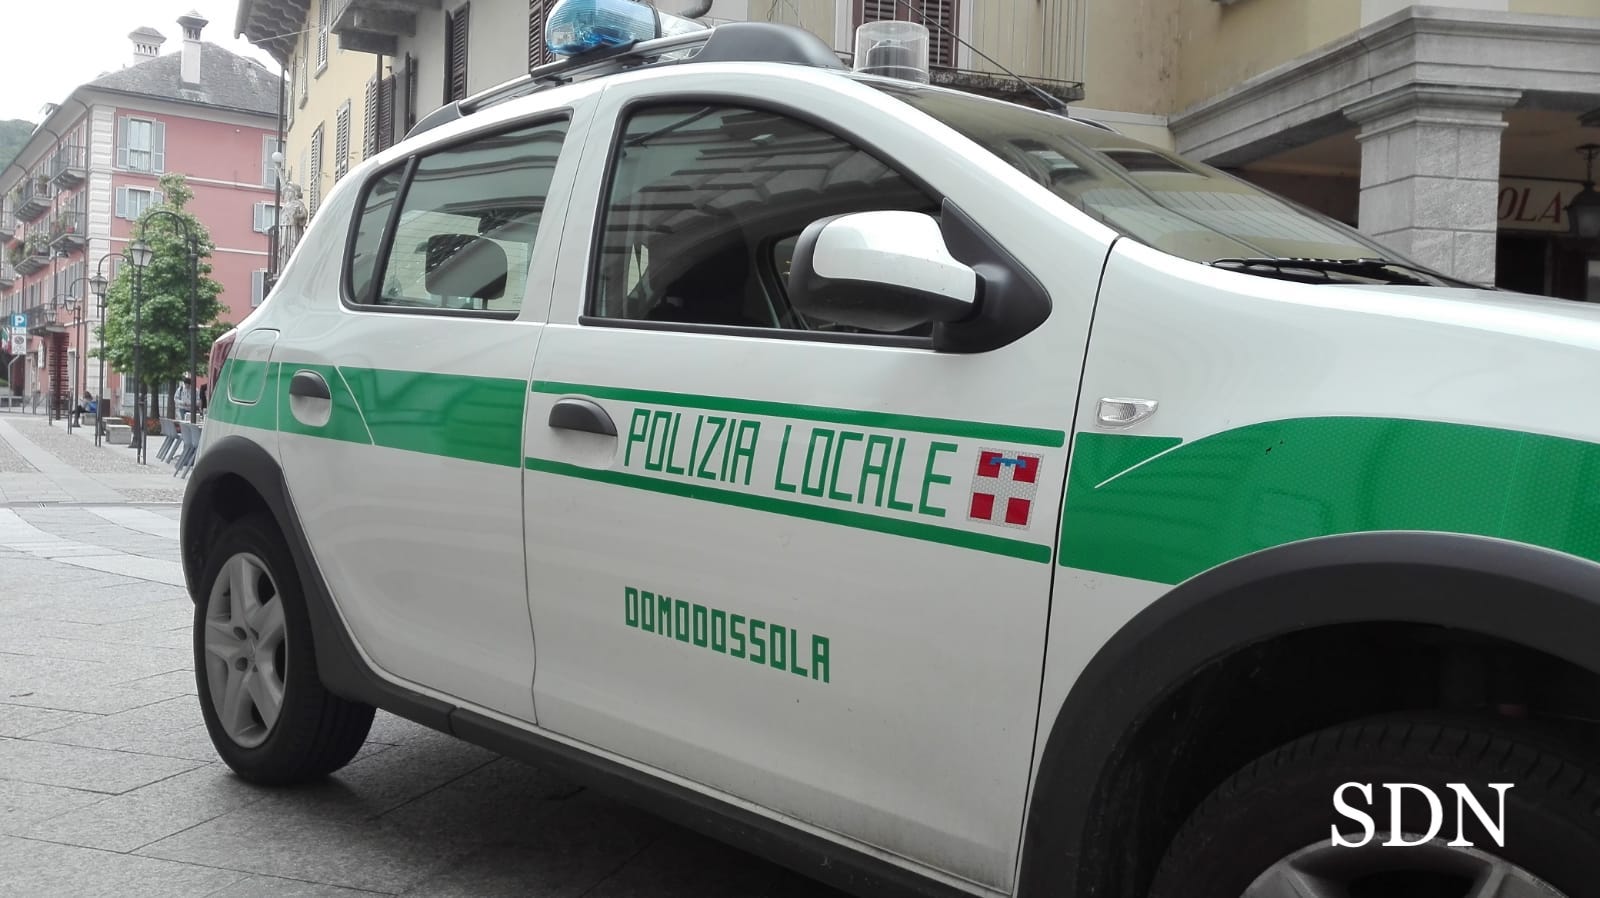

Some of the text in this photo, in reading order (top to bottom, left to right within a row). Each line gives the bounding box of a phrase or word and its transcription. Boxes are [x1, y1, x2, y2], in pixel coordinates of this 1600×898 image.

[14, 315, 25, 326] P
[624, 408, 958, 518] POLIZIA LOCALE
[624, 586, 830, 683] DOMODOSSOLA
